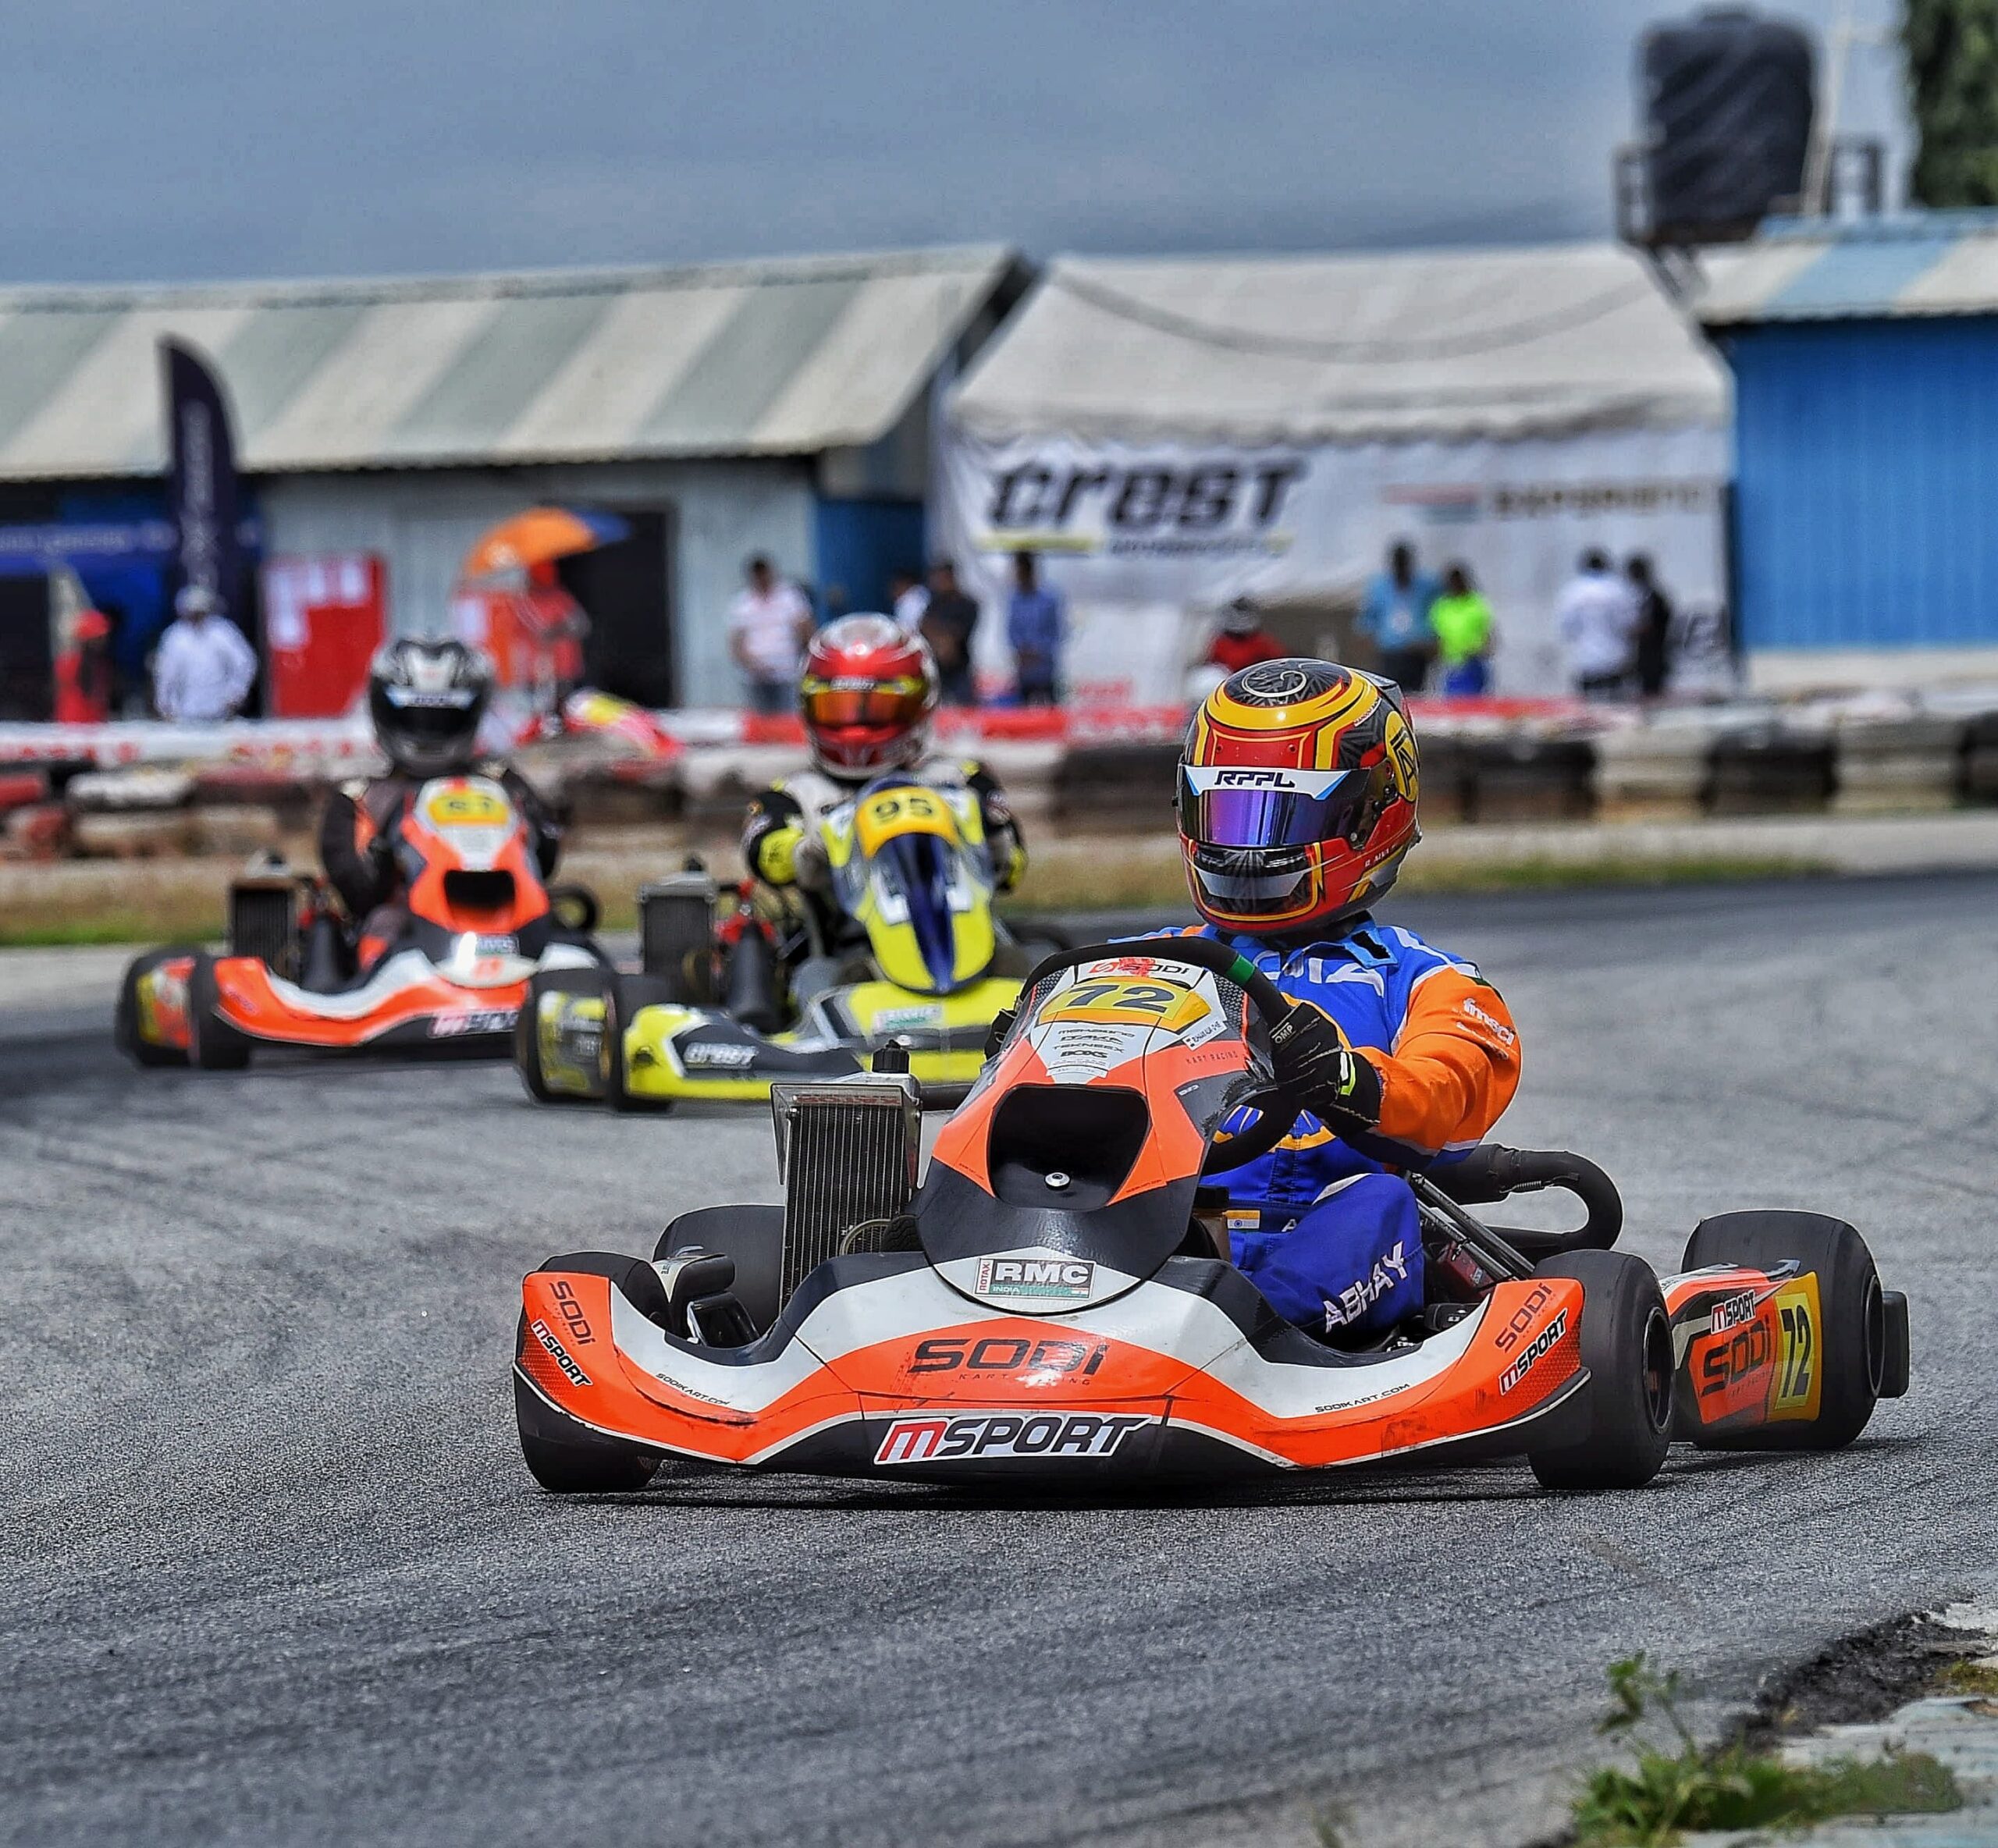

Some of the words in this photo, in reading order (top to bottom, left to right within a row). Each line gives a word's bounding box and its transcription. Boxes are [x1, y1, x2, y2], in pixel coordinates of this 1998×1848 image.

[1214, 770, 1296, 788] RPPL
[875, 796, 933, 818] 95
[1066, 985, 1175, 1014] 72
[1275, 1025, 1293, 1043] OMP
[979, 1263, 991, 1291] ROTAX
[995, 1262, 1090, 1284] RMC
[1323, 1241, 1408, 1333] ABHAY
[549, 1281, 595, 1345] SODI
[1495, 1282, 1553, 1353] SODI
[907, 1338, 1111, 1375] SODI
[1779, 1304, 1811, 1398] 72
[1315, 1384, 1410, 1413] SODIKART.COM
